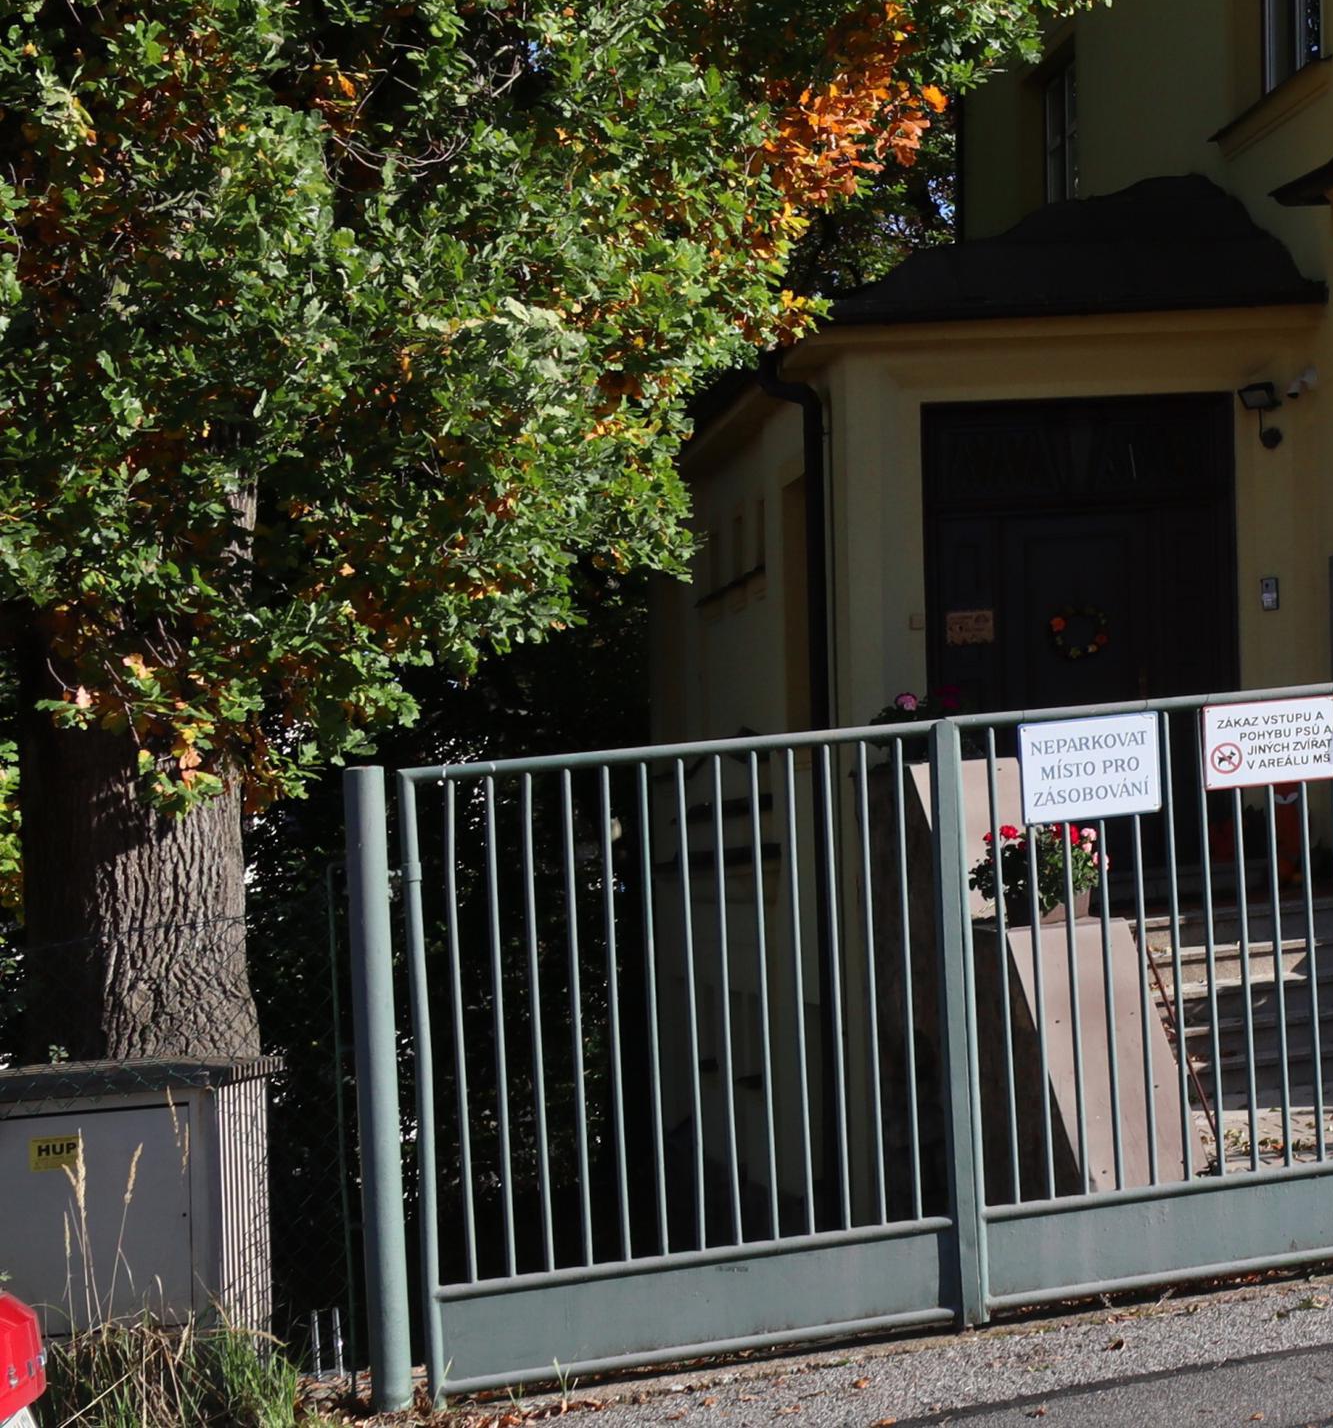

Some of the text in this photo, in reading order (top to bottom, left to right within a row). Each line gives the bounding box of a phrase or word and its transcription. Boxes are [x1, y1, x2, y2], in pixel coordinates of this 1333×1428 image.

[1217, 711, 1324, 729] ZÁKAZ VSTUPU A
[1240, 724, 1333, 742] POHYBU PSŮ A
[1031, 731, 1147, 756] NEPARKOVAT
[1248, 738, 1333, 756] JINÝCH ZVÍŘAT
[1041, 756, 1140, 781] MÍSTO PRO
[1247, 754, 1331, 770] V AREÁLU MŠ
[1034, 775, 1149, 807] ZÁSOBOVÁNÍ
[38, 1143, 77, 1157] HUP
